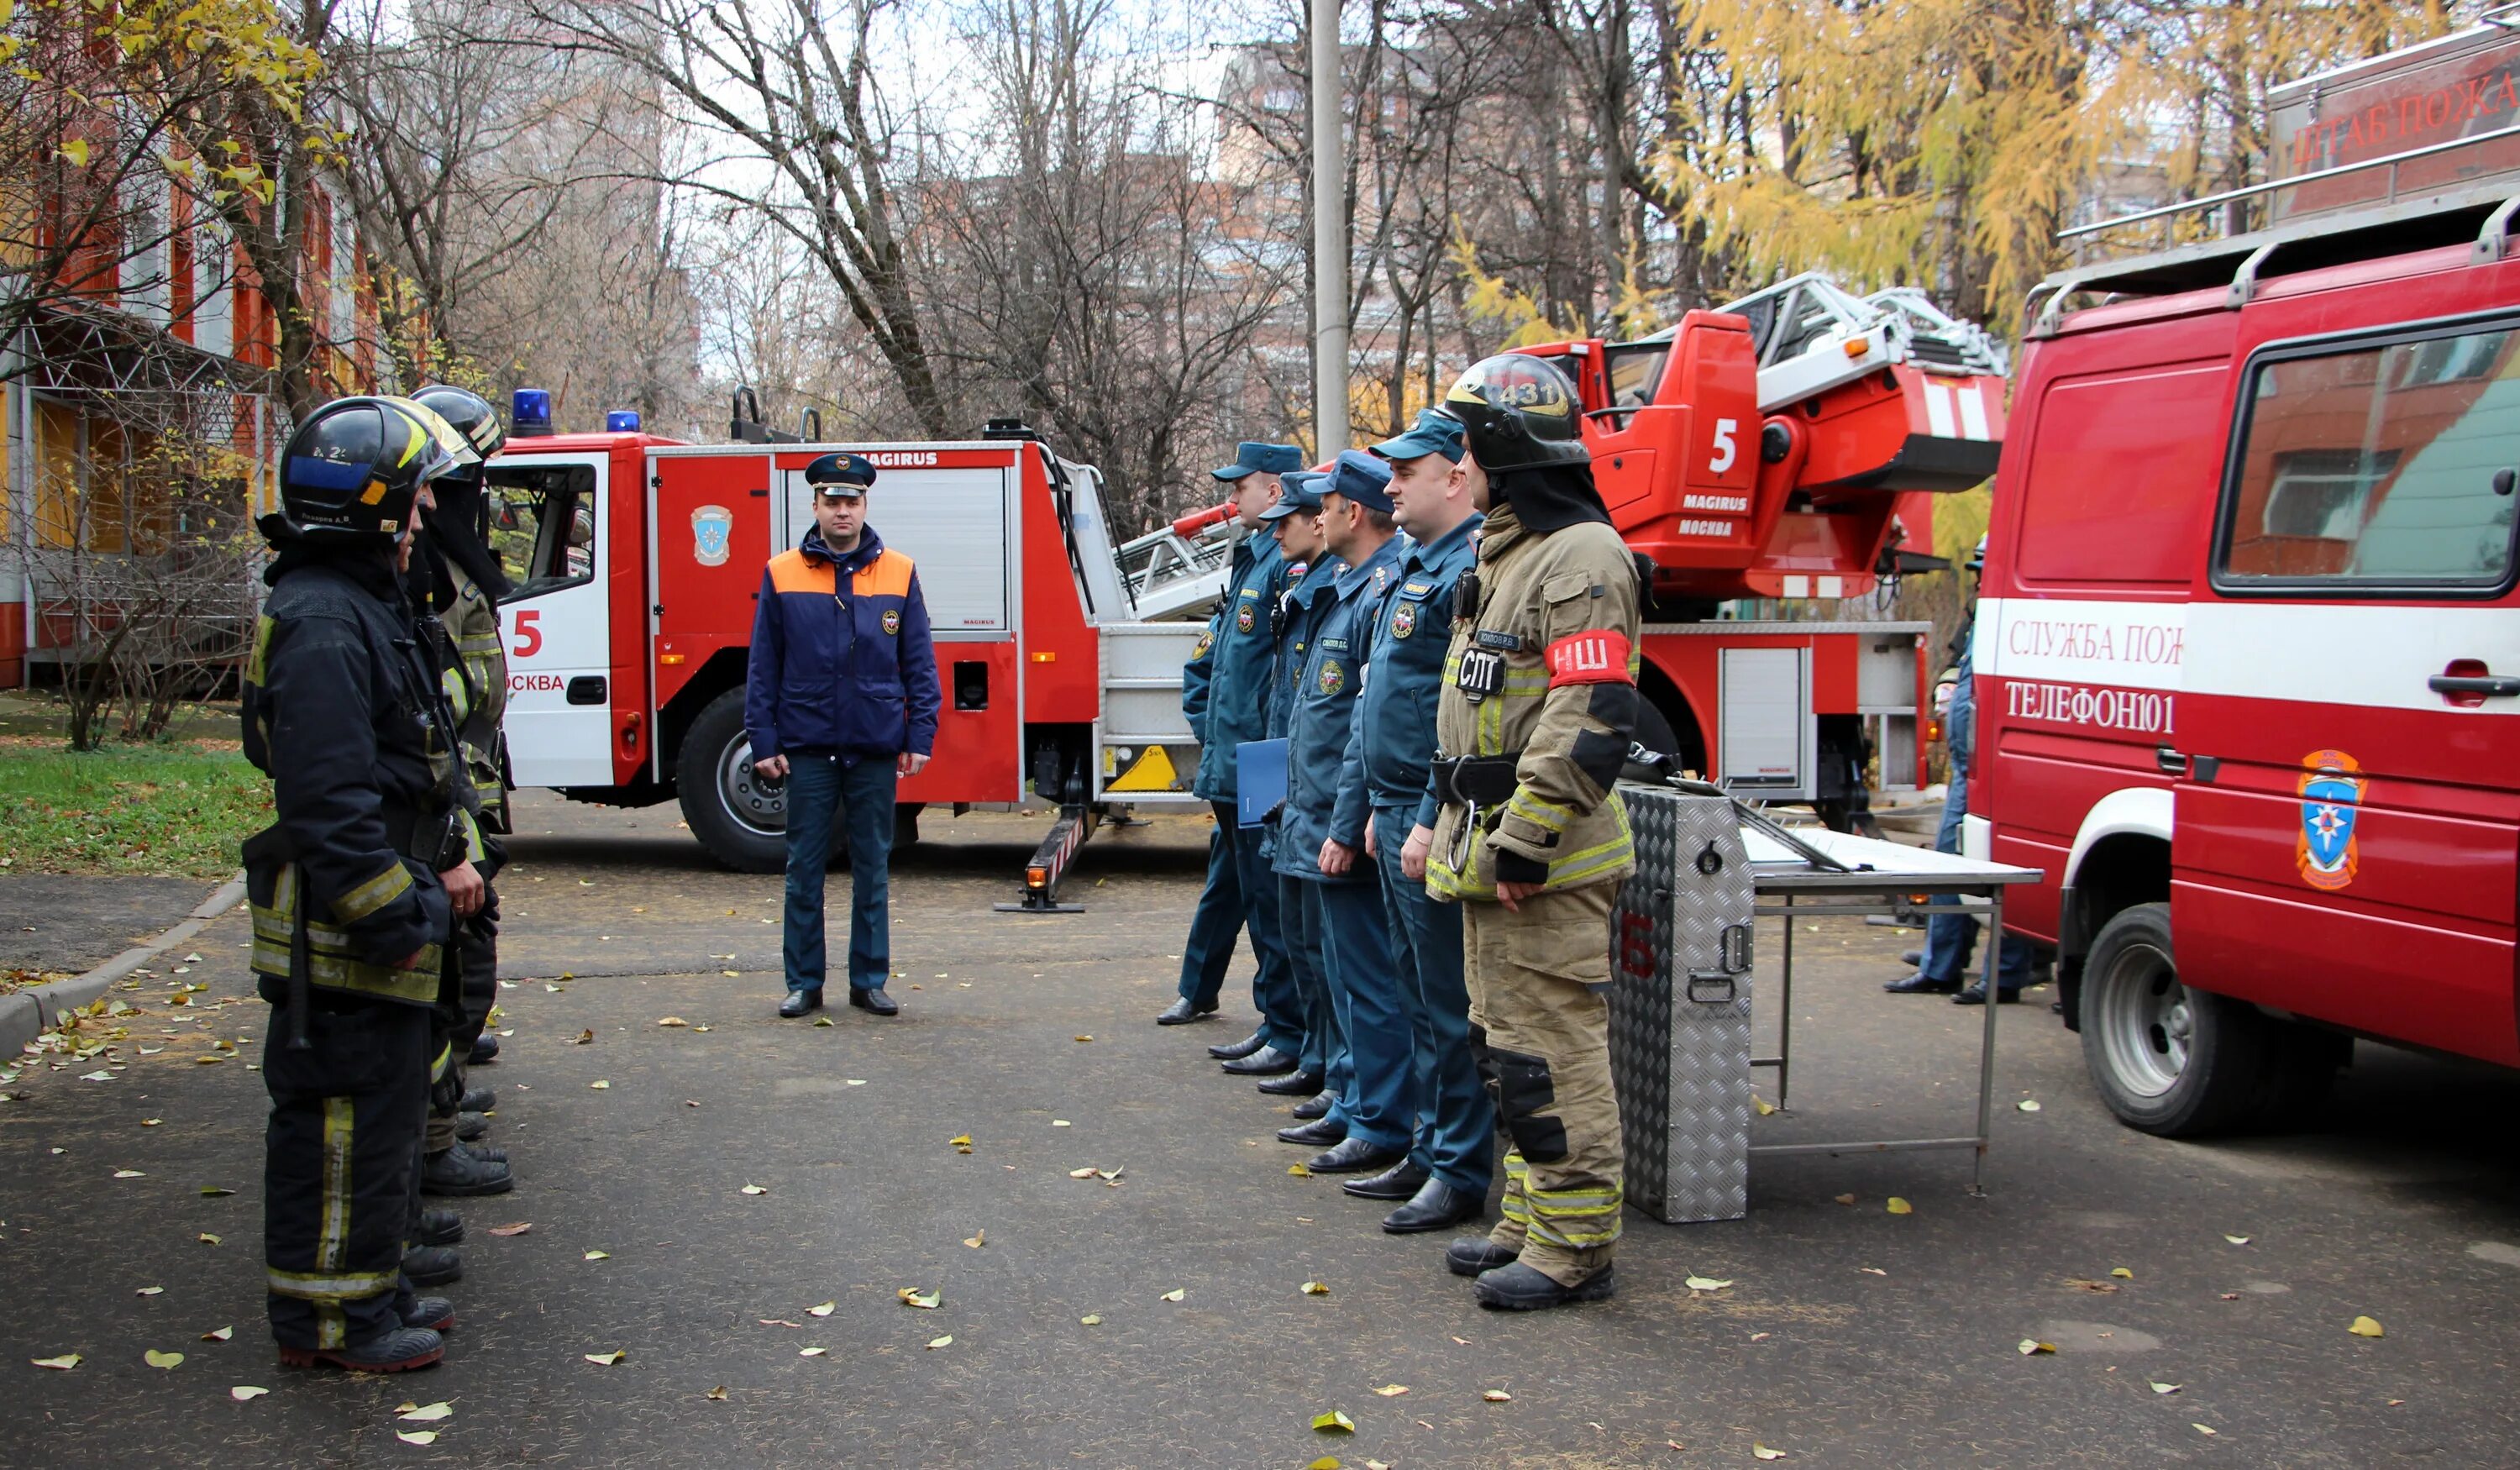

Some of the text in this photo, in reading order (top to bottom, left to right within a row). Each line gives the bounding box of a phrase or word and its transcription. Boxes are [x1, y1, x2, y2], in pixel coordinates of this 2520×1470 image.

[2293, 71, 2520, 165] ШТАБ ПОЖА
[1499, 382, 1553, 406] 431
[1709, 418, 1737, 473] 5
[1683, 494, 1747, 512] MAGIRUS
[1678, 519, 1732, 537] МОСКВА
[513, 610, 543, 657] 5
[2010, 620, 2114, 660] СЛУЖБА
[507, 675, 564, 690] СКВА
[1460, 650, 1499, 690] СПТ
